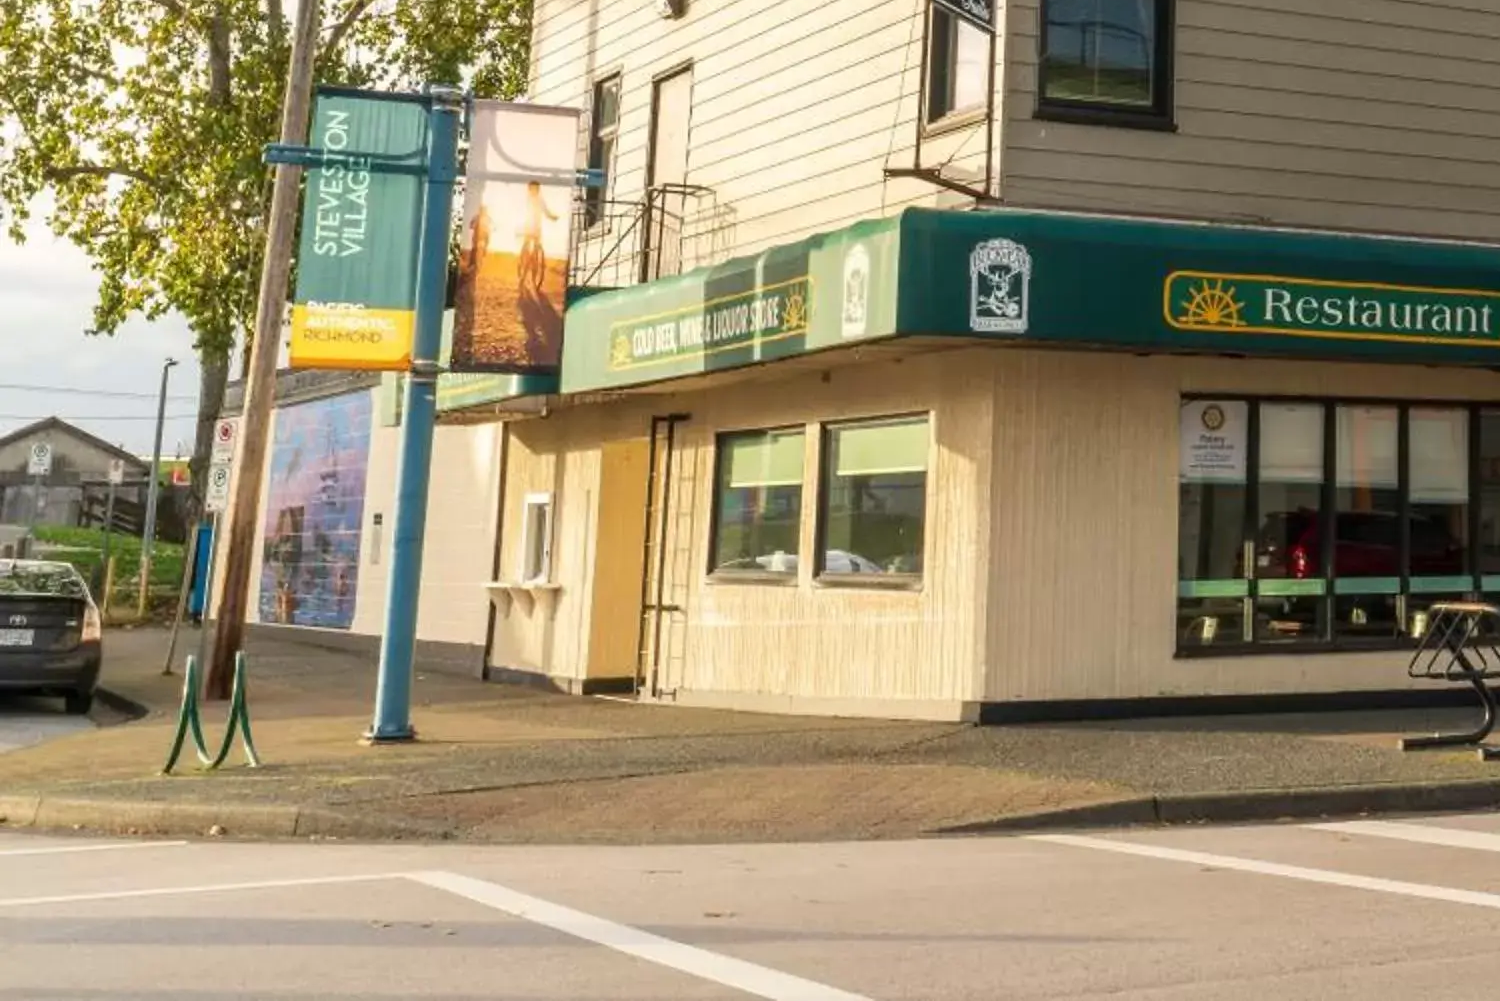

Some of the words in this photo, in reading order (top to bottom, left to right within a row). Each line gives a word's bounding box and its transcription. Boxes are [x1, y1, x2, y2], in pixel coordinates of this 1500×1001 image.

[313, 110, 350, 257] STEVESTON
[339, 156, 371, 258] VILLAGE
[303, 328, 382, 344] RICHMOND
[632, 326, 655, 357] COLD
[679, 315, 704, 346] WINE
[713, 304, 749, 341] LIQUOR
[750, 296, 780, 331] STORE
[1263, 287, 1493, 334] Restaurant
